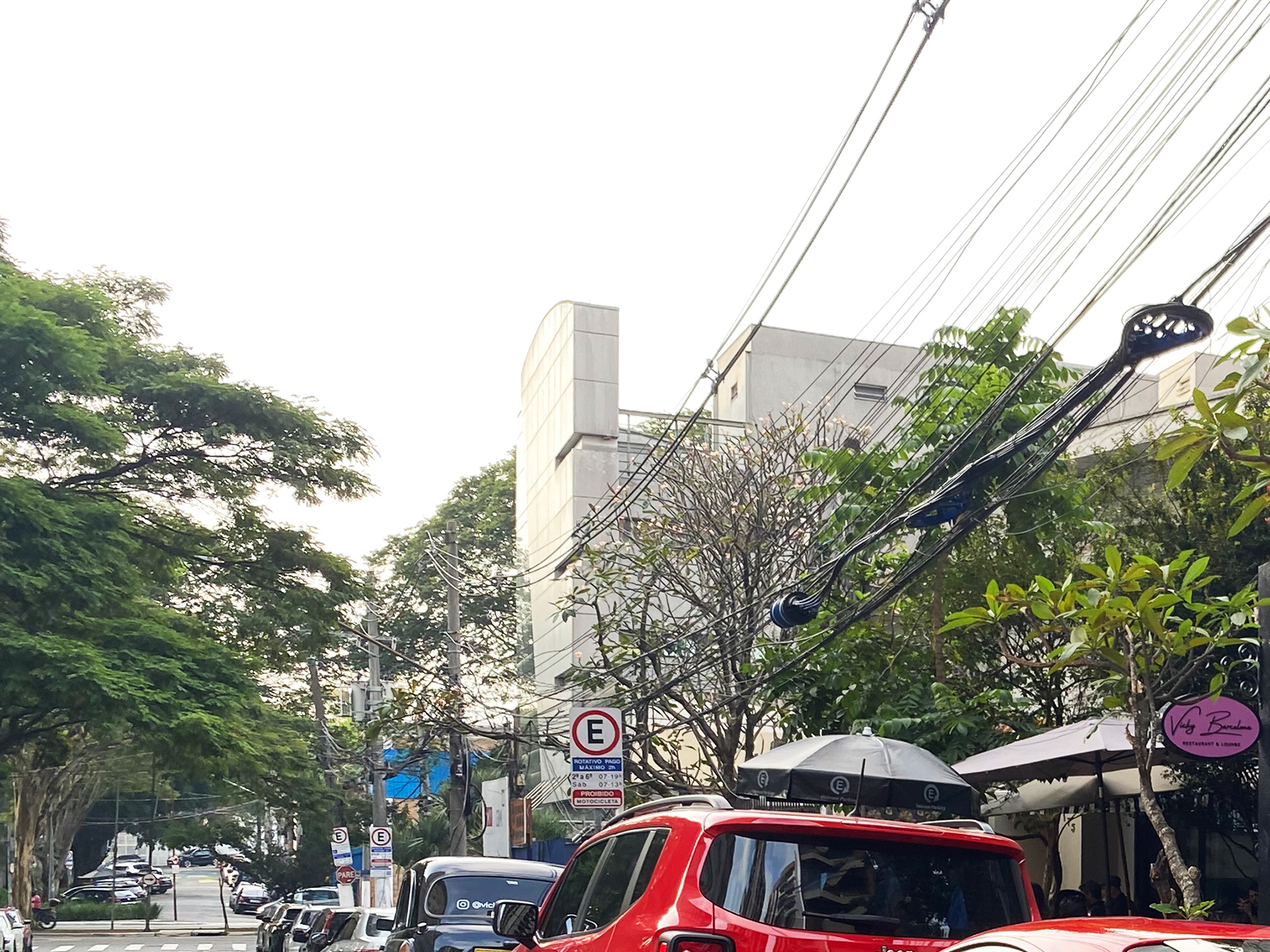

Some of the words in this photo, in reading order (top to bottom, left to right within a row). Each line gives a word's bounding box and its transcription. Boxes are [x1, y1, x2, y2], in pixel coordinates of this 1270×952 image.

[1170, 705, 1201, 736] Vicky
[1202, 710, 1252, 736] Barcelona
[587, 719, 604, 744] E
[377, 831, 385, 842] E
[338, 871, 355, 879] PARE
